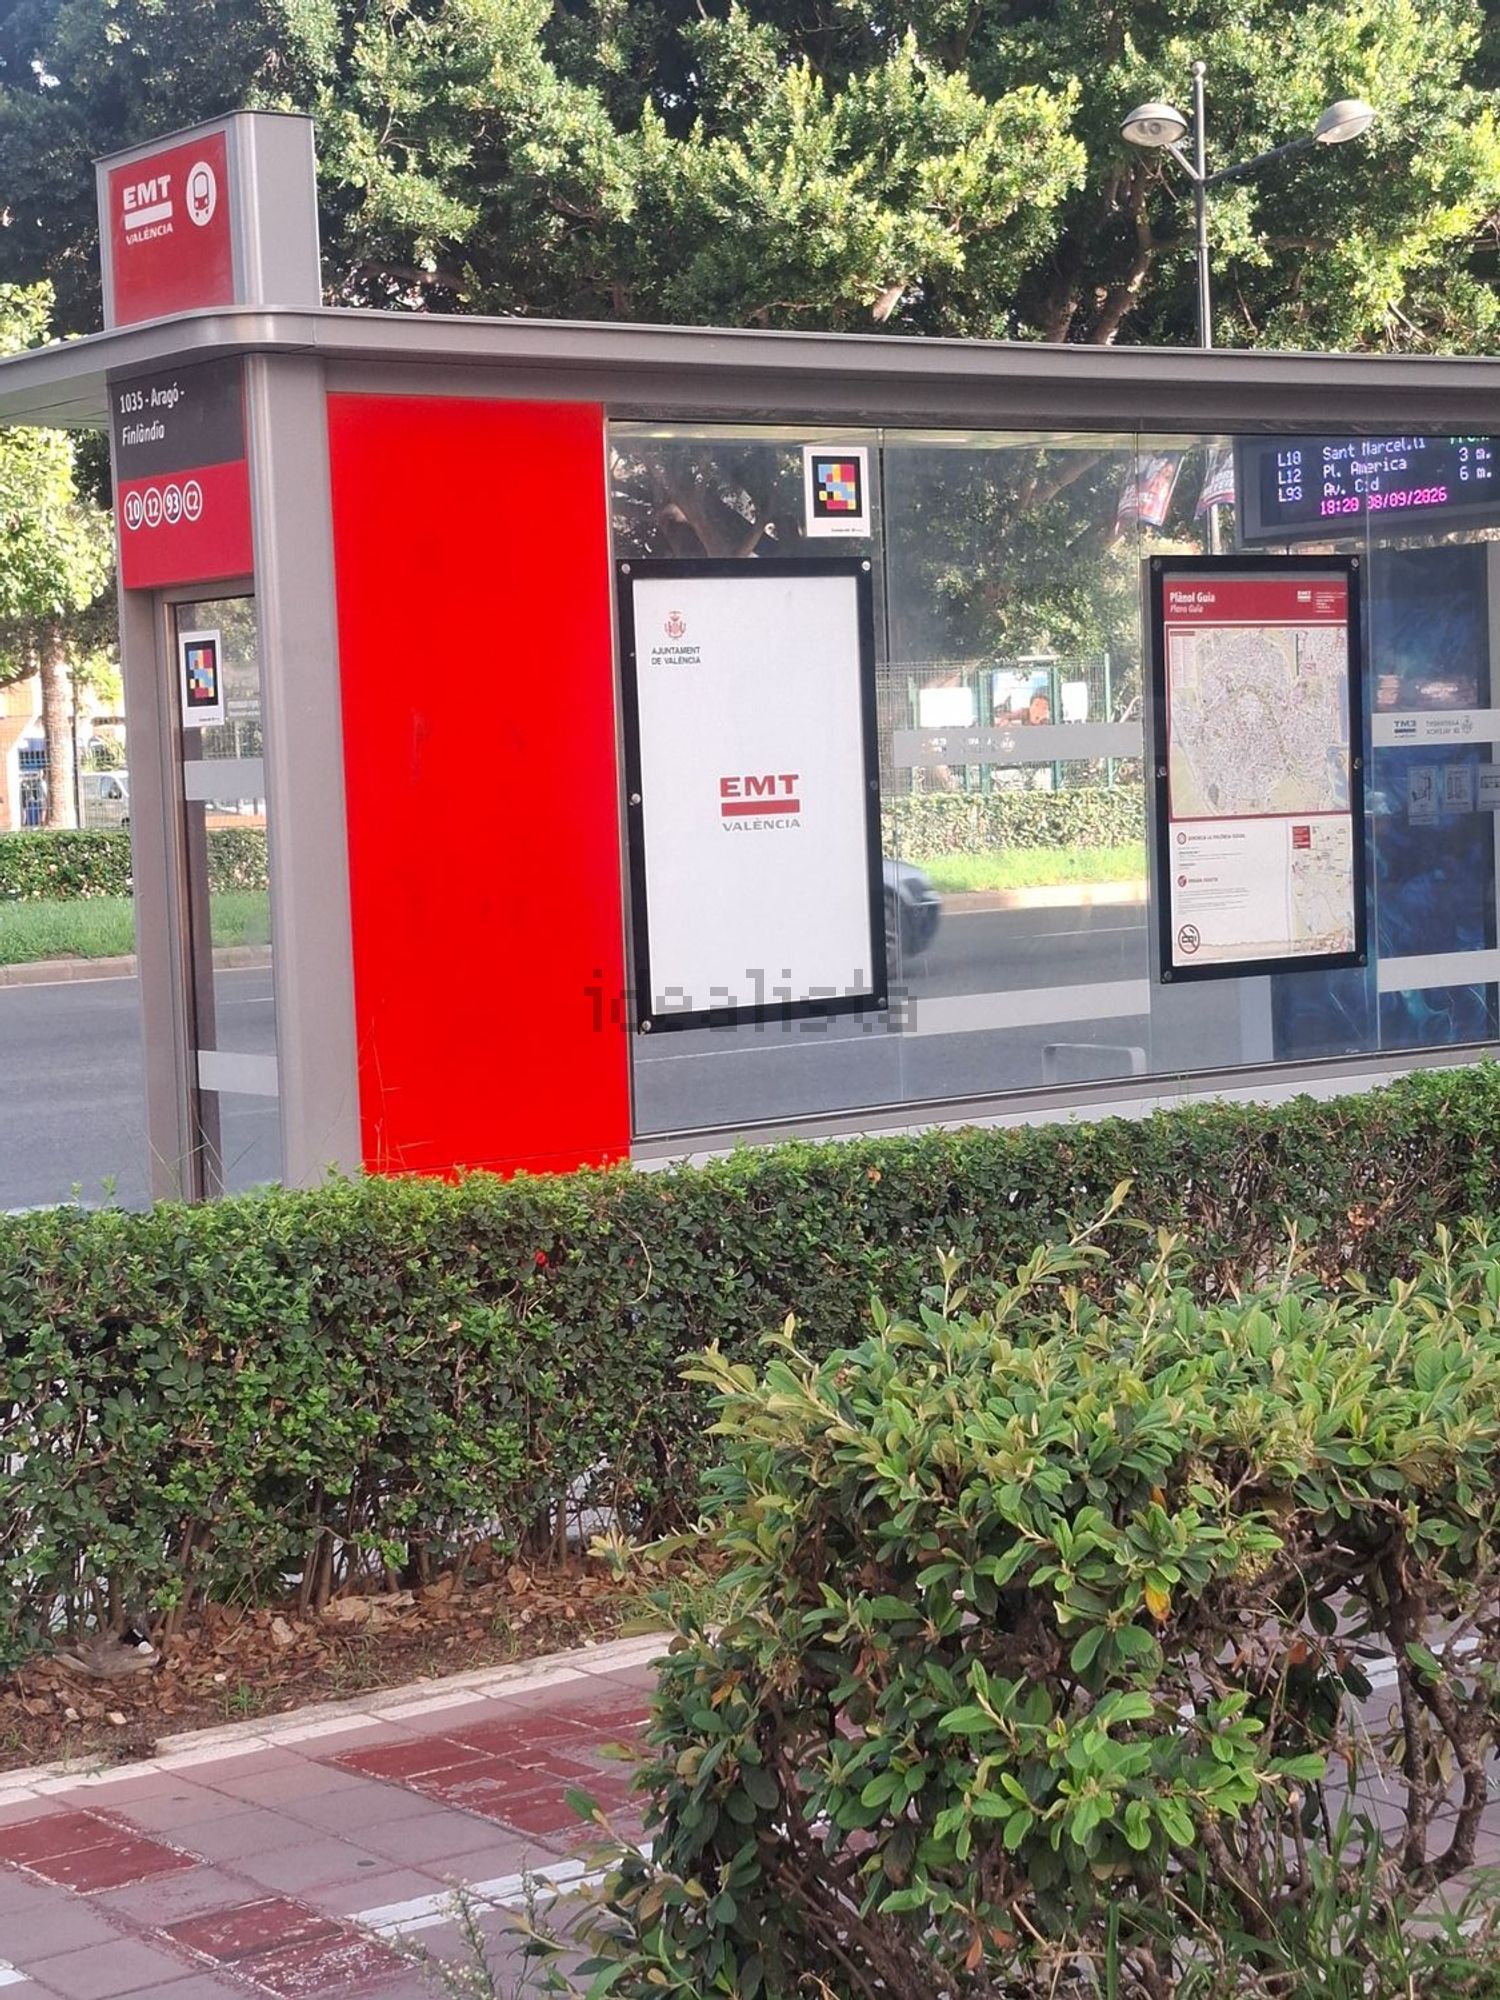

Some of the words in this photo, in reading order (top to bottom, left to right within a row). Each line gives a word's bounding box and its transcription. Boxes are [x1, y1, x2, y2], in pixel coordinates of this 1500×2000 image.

[123, 174, 171, 211] EMT
[125, 222, 173, 245] VALÈNCIA
[120, 391, 143, 413] 1035
[151, 382, 179, 409] Aragó
[122, 420, 165, 446] Finlàndia
[1322, 443, 1355, 460] Sant
[1278, 469, 1302, 485] L12
[1323, 464, 1341, 479] Pl.
[1458, 446, 1468, 462] 3
[1278, 486, 1303, 502] L93
[1323, 482, 1346, 497] Av.
[1355, 477, 1380, 493] Cid
[1459, 465, 1469, 481] 6
[1476, 467, 1492, 479] m.
[127, 500, 140, 521] 10
[147, 498, 158, 518] 12
[167, 492, 179, 514] 93
[186, 491, 198, 511] C2
[1320, 497, 1359, 516] 18:20
[1197, 591, 1216, 603] Guia
[651, 646, 701, 655] AJUNTAMENT
[651, 657, 662, 665] DE
[664, 655, 701, 665] VALÈNCIA
[720, 774, 799, 798] EMT
[722, 818, 800, 832] VALÈNCIA
